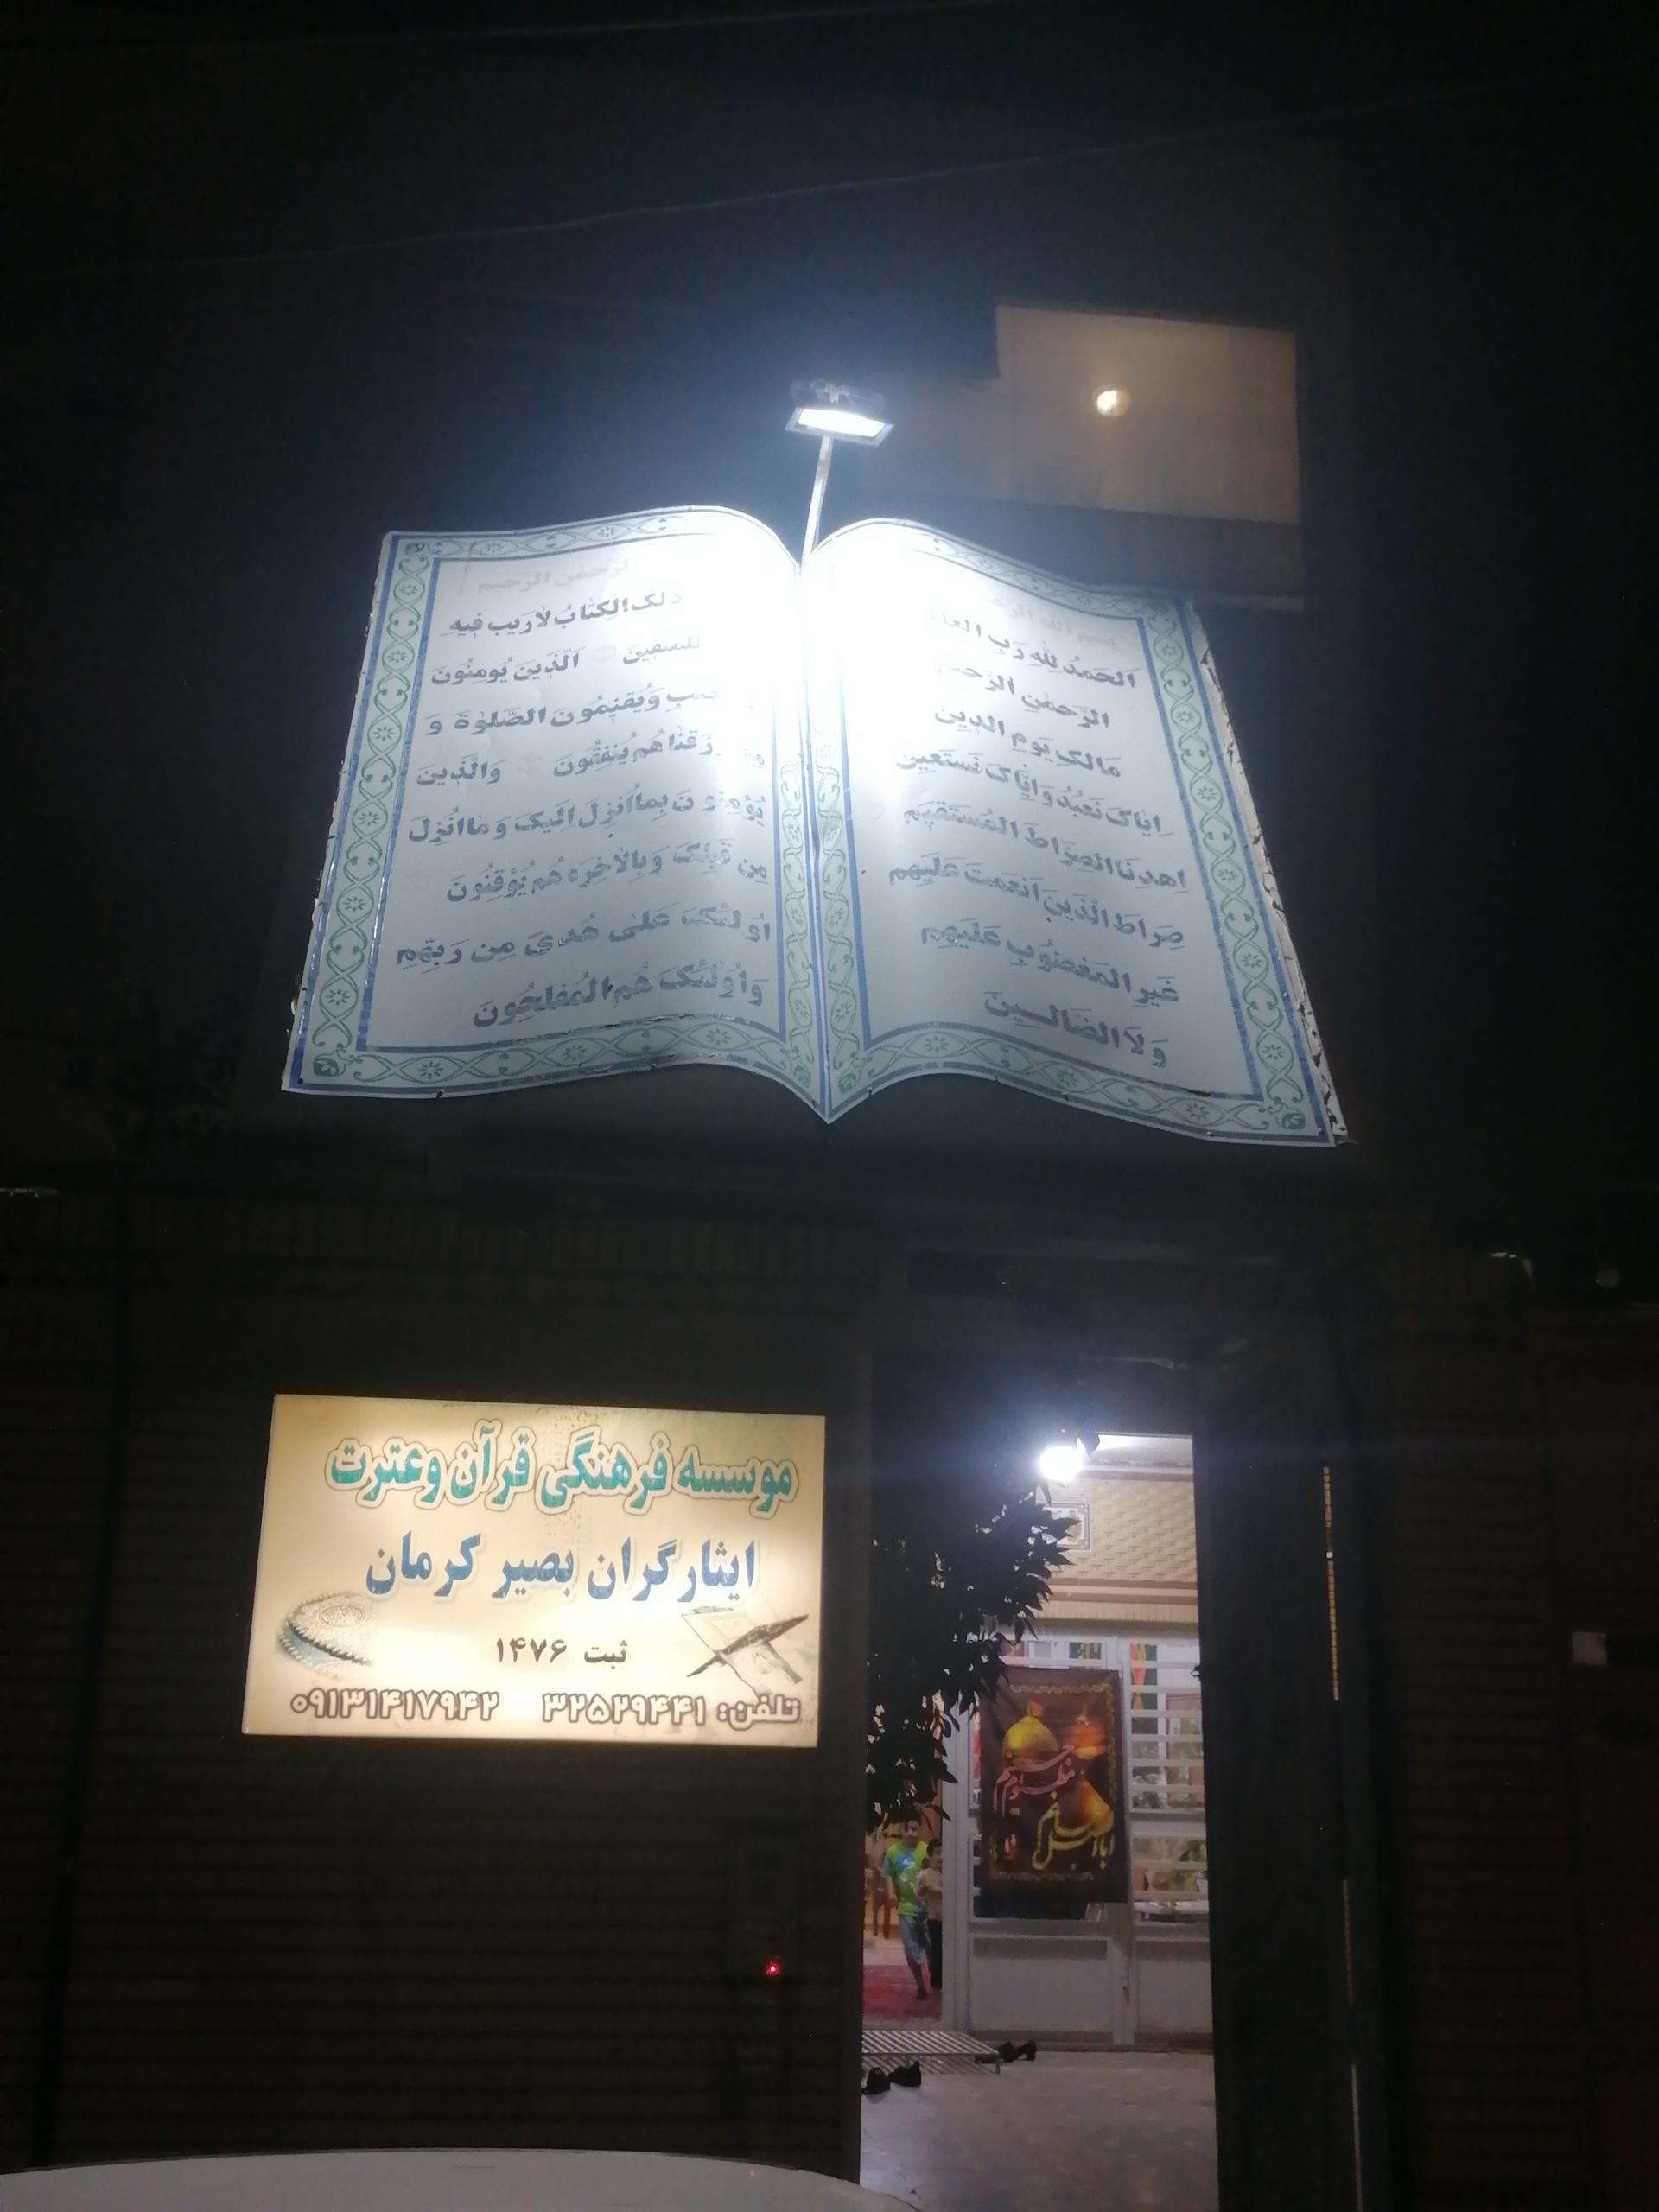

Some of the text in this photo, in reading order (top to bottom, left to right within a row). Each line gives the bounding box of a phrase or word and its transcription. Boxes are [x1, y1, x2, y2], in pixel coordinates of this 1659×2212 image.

[449, 1425, 532, 1506] قرآن
[539, 1430, 669, 1510] فرهنگی
[676, 1450, 795, 1515] موسسه
[365, 1529, 482, 1597] کرمان
[491, 1549, 575, 1599] بصیر
[496, 1637, 628, 1666] ثبت ۱۴۷۶
[541, 1693, 707, 1725] ۳۲۵۲۹۴۴۱
[715, 1694, 802, 1730] تلفن:
